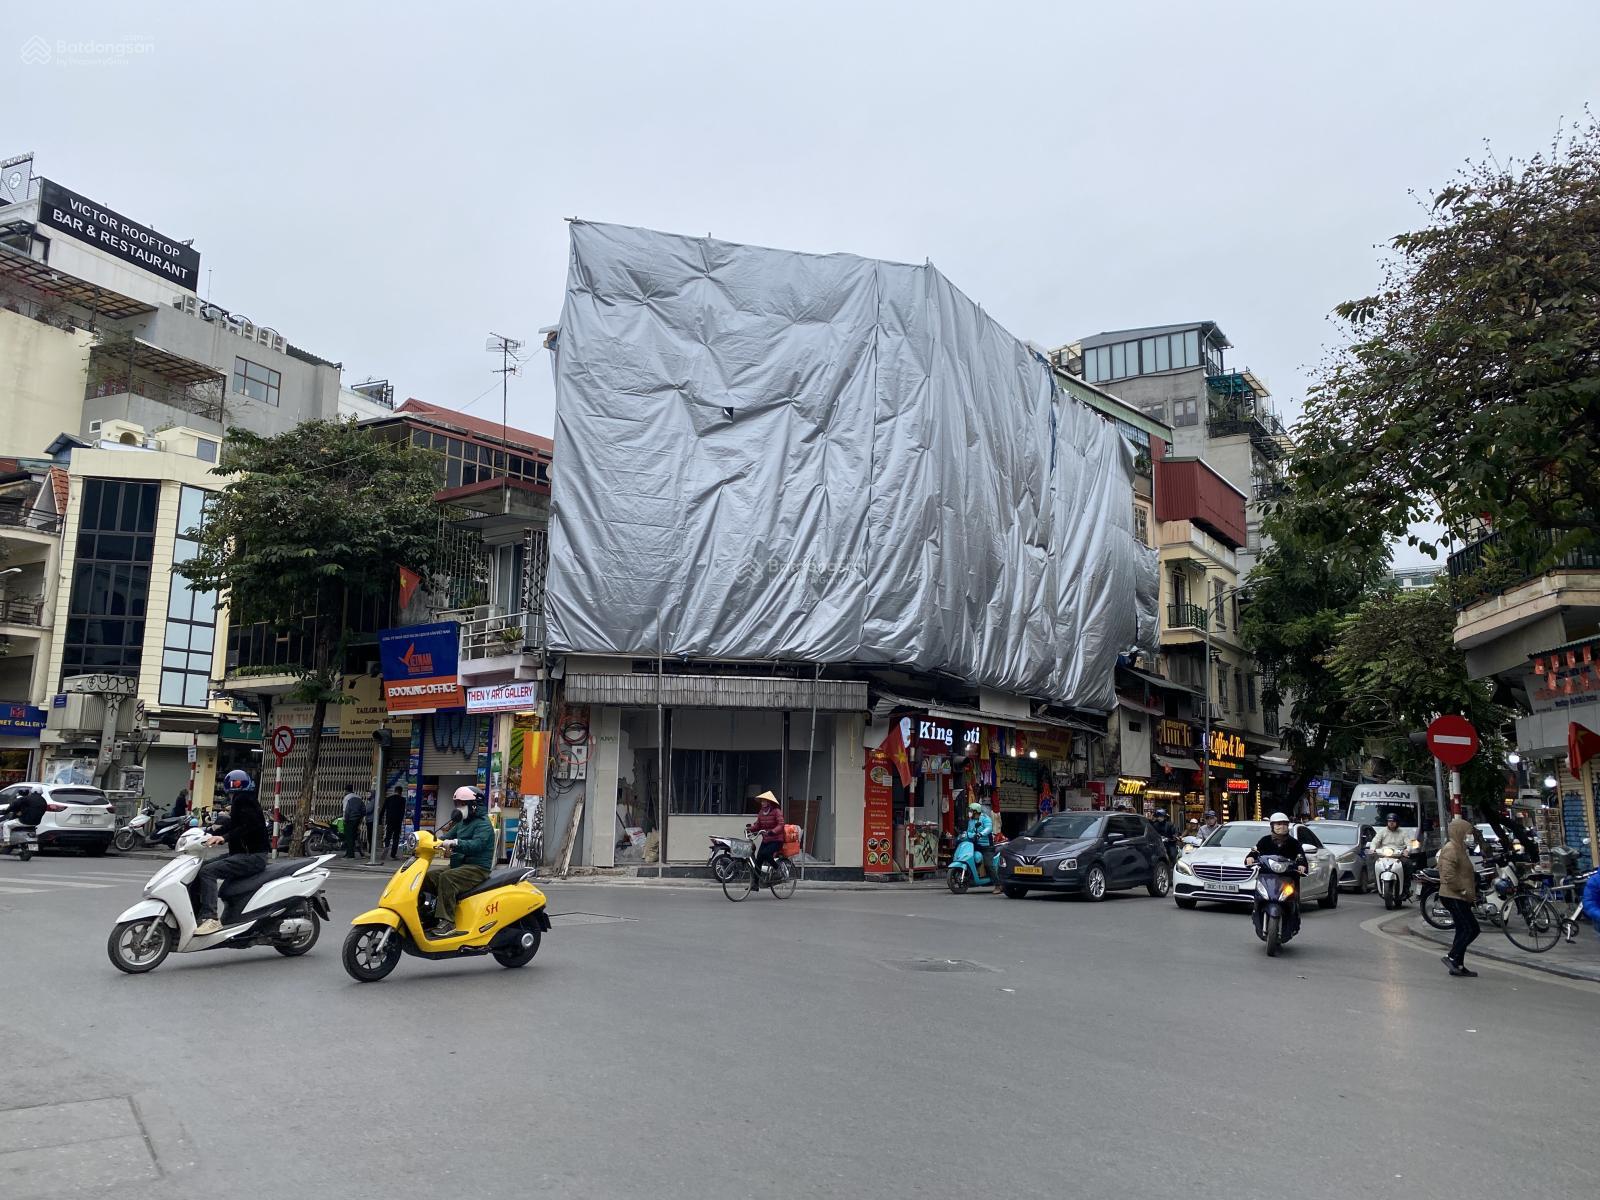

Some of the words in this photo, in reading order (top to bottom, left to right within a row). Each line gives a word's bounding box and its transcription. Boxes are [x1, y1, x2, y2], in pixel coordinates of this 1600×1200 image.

[69, 198, 118, 230] VICTOR
[121, 223, 180, 257] ROOFTOP
[52, 208, 83, 232] BAR
[86, 224, 96, 238] &
[100, 230, 188, 279] RESTAURANT
[388, 685, 426, 697] BOOKING
[427, 683, 458, 694] OFFICE
[491, 688, 504, 700] ART
[504, 686, 533, 698] GALLERY
[919, 721, 953, 746] King
[1209, 730, 1228, 760] Coffee
[1228, 735, 1234, 756] &
[1235, 736, 1245, 758] Tea
[1383, 791, 1410, 799] VAN
[485, 901, 499, 916] SH
